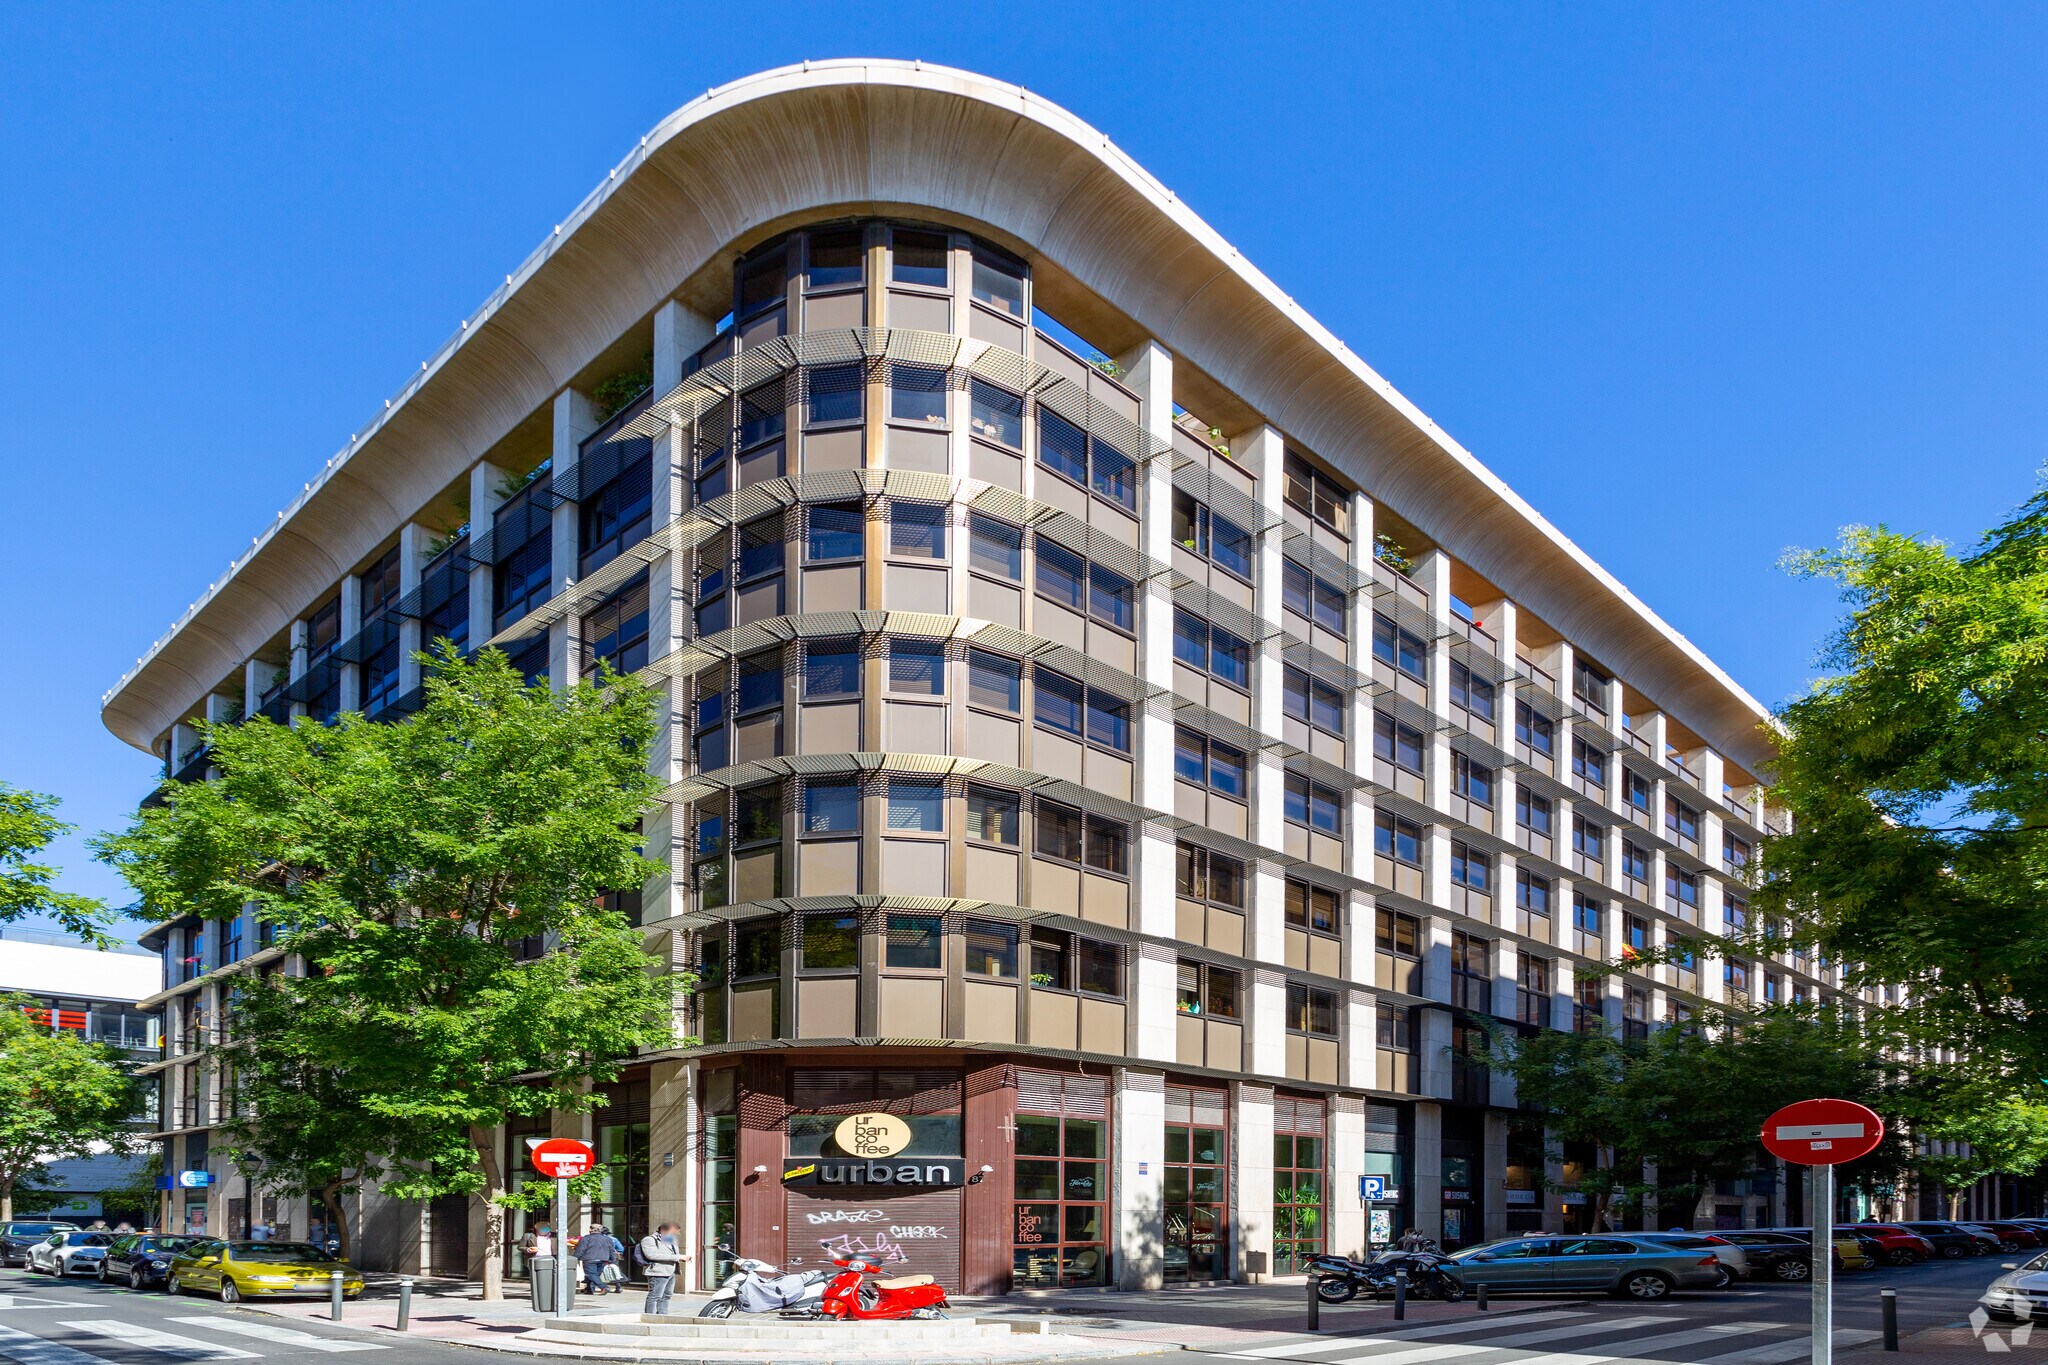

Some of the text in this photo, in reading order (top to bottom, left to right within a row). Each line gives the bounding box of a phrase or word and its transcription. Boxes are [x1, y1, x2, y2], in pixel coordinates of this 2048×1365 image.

[855, 1116, 873, 1125] ur
[855, 1124, 888, 1136] ban
[855, 1135, 878, 1144] co
[855, 1142, 890, 1154] ffee
[821, 1160, 950, 1183] urban
[1365, 1179, 1380, 1198] P
[1018, 1206, 1031, 1215] ur
[1019, 1214, 1042, 1225] ban
[1019, 1223, 1034, 1232] co
[1018, 1231, 1042, 1243] ffee
